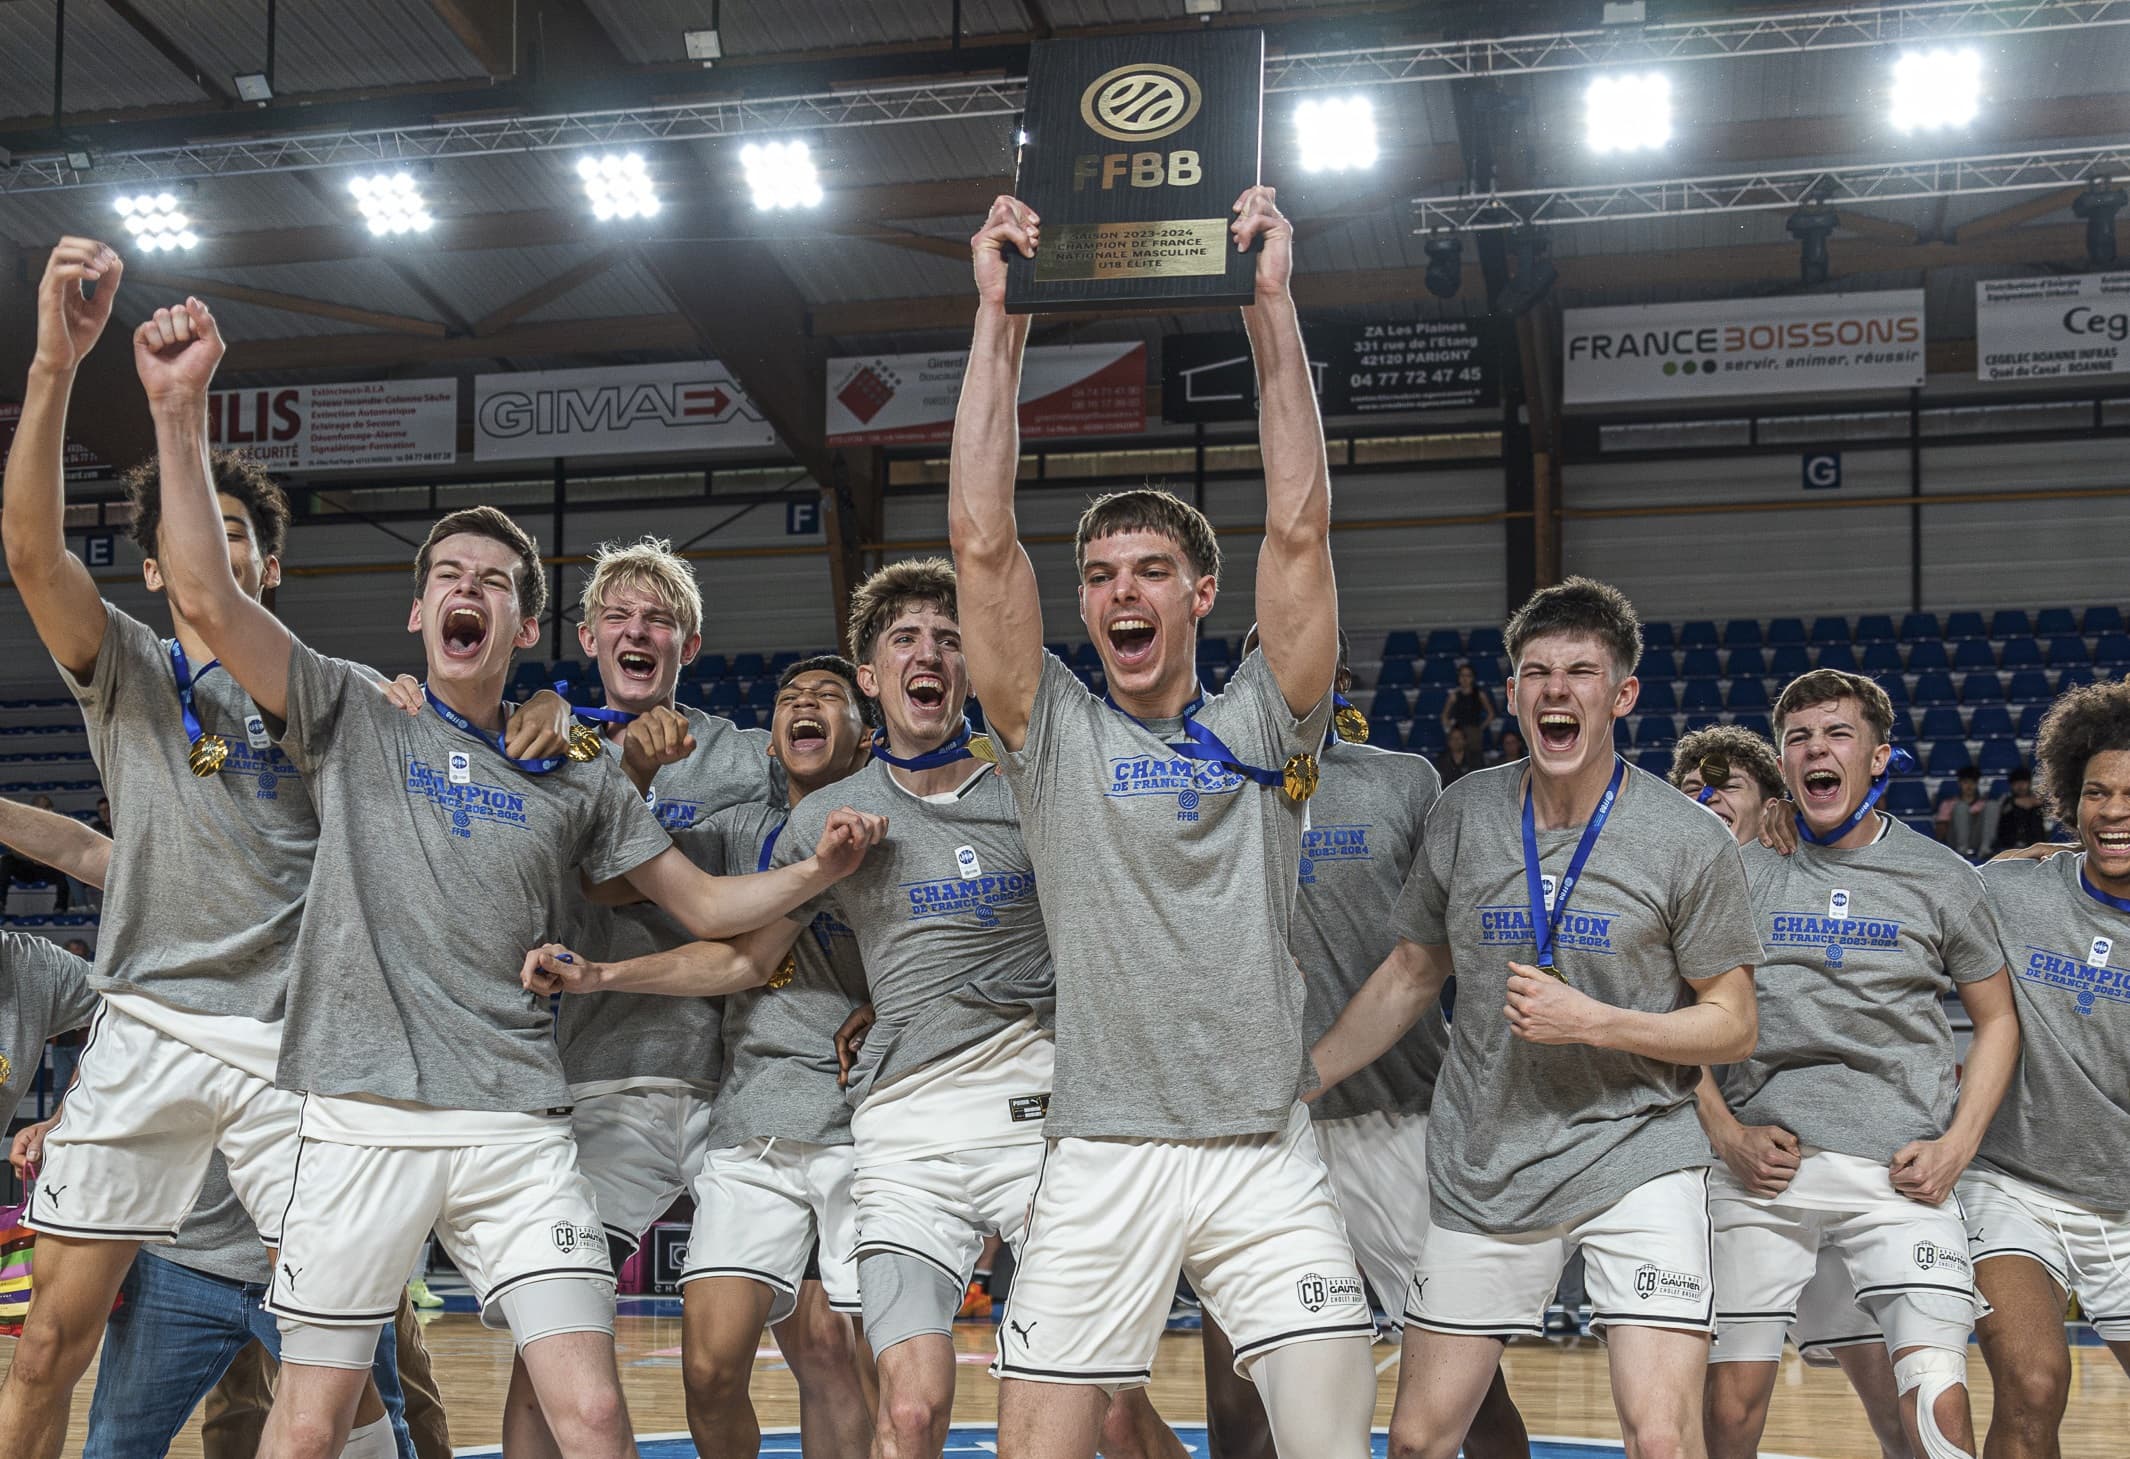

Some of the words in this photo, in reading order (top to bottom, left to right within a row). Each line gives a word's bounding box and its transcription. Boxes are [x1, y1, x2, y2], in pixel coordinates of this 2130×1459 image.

[1073, 150, 1202, 192] FFBB
[1072, 231, 1118, 240] SAISON
[1124, 229, 1193, 239] 2023-2024
[1056, 250, 1128, 260] NATIONALE
[1133, 247, 1207, 258] MASCULINE
[1057, 241, 1126, 251] CHAMPION
[1132, 240, 1148, 248] DE
[1153, 238, 1202, 247] FRANCE
[1099, 261, 1121, 269] U18
[1365, 326, 1385, 337] ZA
[1388, 325, 1412, 336] Les
[1416, 323, 1467, 334] Plaines
[2063, 306, 2129, 341] Ceg
[1353, 341, 1378, 352] 331
[1382, 342, 1406, 351] rue
[1409, 339, 1426, 349] de
[1569, 328, 1718, 361] FRANCE
[1724, 317, 1920, 352] BOISSONS
[1360, 355, 1403, 366] 42120
[1406, 350, 1470, 364] PARIGNY
[1725, 357, 1780, 371] servir,
[1785, 354, 1849, 368] animer,
[1855, 350, 1920, 364] réussir
[1985, 353, 2029, 365] CEGELEC
[2032, 350, 2076, 362] ROANNE
[1350, 373, 1372, 388] 04
[1377, 372, 1399, 386] 77
[1405, 371, 1427, 385] 72
[1431, 369, 1454, 383] 47
[1458, 366, 1482, 381] 45
[1990, 367, 2013, 379] Quai
[2069, 361, 2112, 372] ROANNE
[312, 411, 356, 419] Extinction
[358, 408, 416, 417] Automatique
[366, 419, 401, 427] Secours
[415, 453, 424, 461] 77
[1808, 456, 1837, 486] G
[793, 504, 813, 534] F
[91, 538, 109, 564] E
[1112, 781, 1129, 792] DE
[1133, 778, 1189, 790] FRANCE
[464, 804, 527, 823] 2023-2024
[650, 803, 697, 820] ION
[1177, 811, 1199, 821] FFBB
[452, 827, 471, 838] FFBB
[912, 904, 928, 914] DE
[932, 897, 979, 911] FRANCE
[1482, 911, 1609, 937] CHAION
[1773, 916, 1899, 939] CHAMPION
[1483, 930, 1495, 940] DE
[1499, 930, 1536, 941] FRANC
[1553, 932, 1611, 948] 023-2024
[1772, 932, 1786, 941] DE
[1790, 932, 1835, 944] FRANCE
[1839, 937, 1898, 948] 2023-2024
[1824, 960, 1842, 969] FFBB
[2030, 952, 2130, 990] CHAMPIO
[2026, 967, 2041, 978] DE
[2044, 971, 2090, 990] FRANCE
[2093, 984, 2130, 999] 2023-2
[556, 1228, 575, 1246] CB
[1917, 1246, 1935, 1264] CB
[1637, 1271, 1656, 1291] CB
[1661, 1278, 1700, 1291] GAUTIER
[1302, 1281, 1324, 1304] CB
